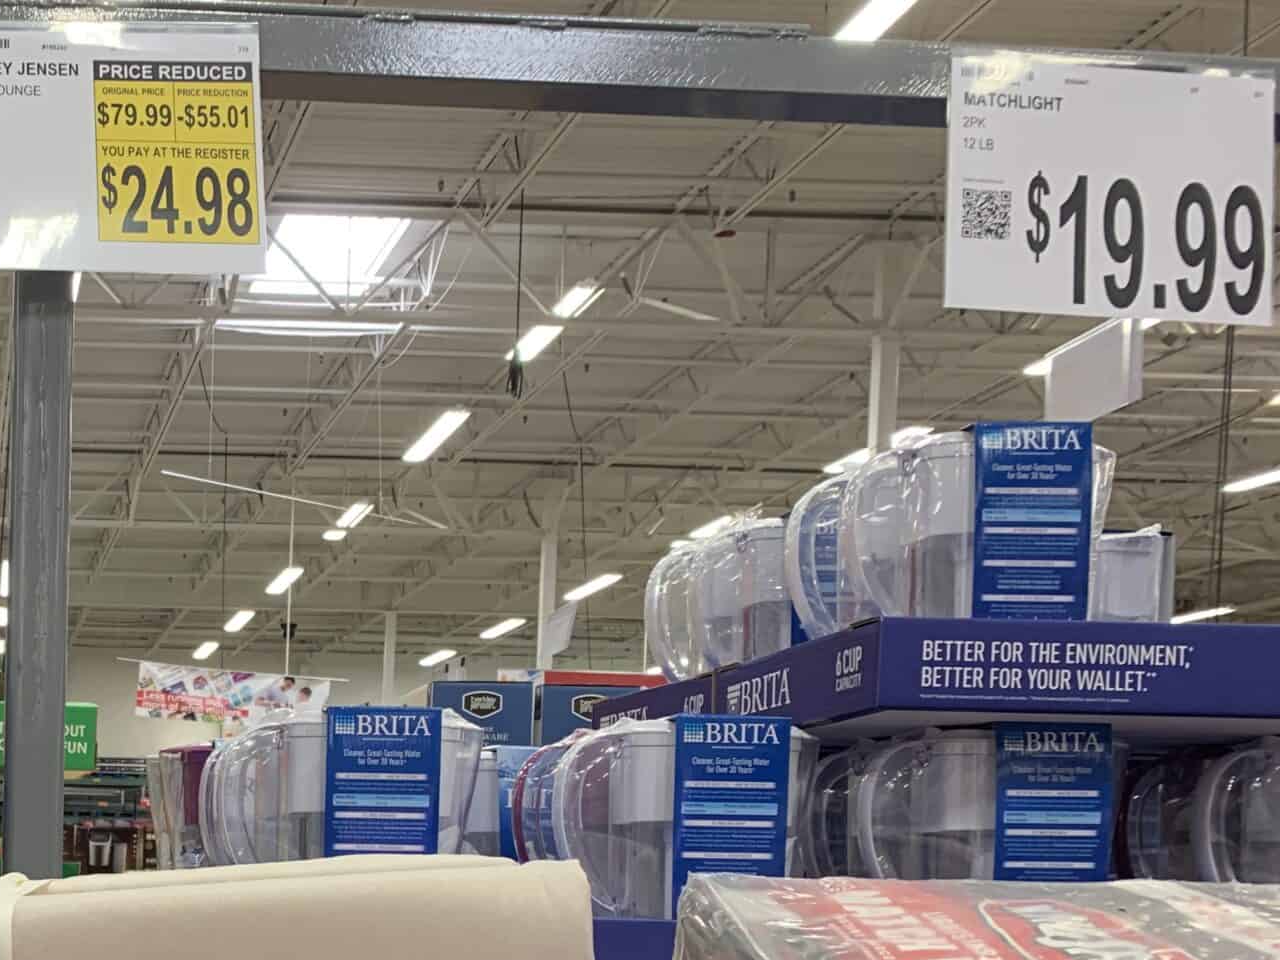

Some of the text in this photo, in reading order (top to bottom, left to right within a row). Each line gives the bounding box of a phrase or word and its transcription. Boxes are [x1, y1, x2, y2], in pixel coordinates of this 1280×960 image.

[17, 62, 79, 77] JENSEN
[99, 64, 246, 80] PRICE REDUCED
[102, 87, 164, 96] ORIGINAL PRICE
[177, 88, 248, 97] PRICE REDUCTION
[963, 92, 1064, 112] MATCHLIGHT
[97, 102, 172, 127] $79.99
[177, 104, 249, 130] -$55.01
[962, 115, 986, 129] 2PK
[102, 146, 250, 160] YOU PAY AT THE REGISTER
[963, 137, 994, 151] 12 LB
[101, 164, 253, 237] $24.98
[1026, 170, 1266, 316] $19.99
[1006, 428, 1082, 450] BRITA
[842, 646, 862, 674] CUP
[922, 640, 985, 662] BETTER
[991, 642, 1023, 663] FOR
[1029, 642, 1060, 664] THE
[921, 667, 984, 688] BETTER
[990, 668, 1022, 688] FOR
[1028, 668, 1071, 690] YOUR
[740, 668, 791, 715] BRITA
[357, 714, 432, 736] BRITA
[705, 723, 780, 744] BRITA
[1025, 731, 1099, 753] BRITA
